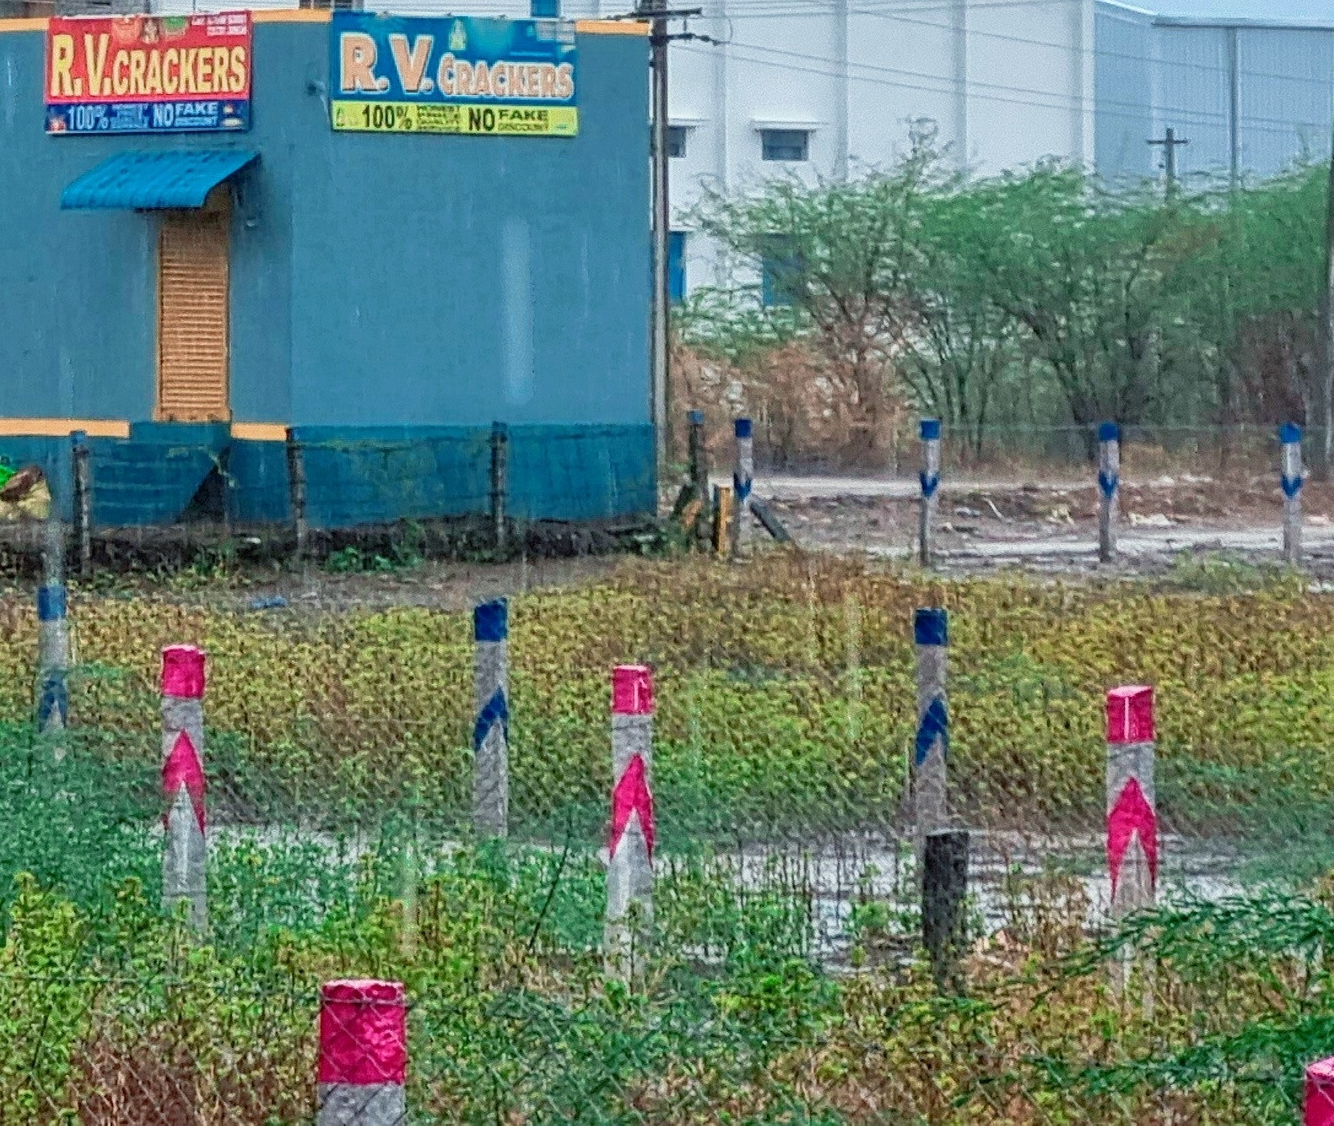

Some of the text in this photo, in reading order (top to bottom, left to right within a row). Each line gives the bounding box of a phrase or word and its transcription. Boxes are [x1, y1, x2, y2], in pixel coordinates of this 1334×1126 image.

[438, 52, 575, 100] CRACKERS
[68, 105, 110, 130] 100%
[153, 103, 175, 128] NO
[175, 102, 218, 116] FAKE
[362, 104, 413, 130] 100%
[468, 106, 496, 132] NO
[497, 109, 548, 122] FAKE
